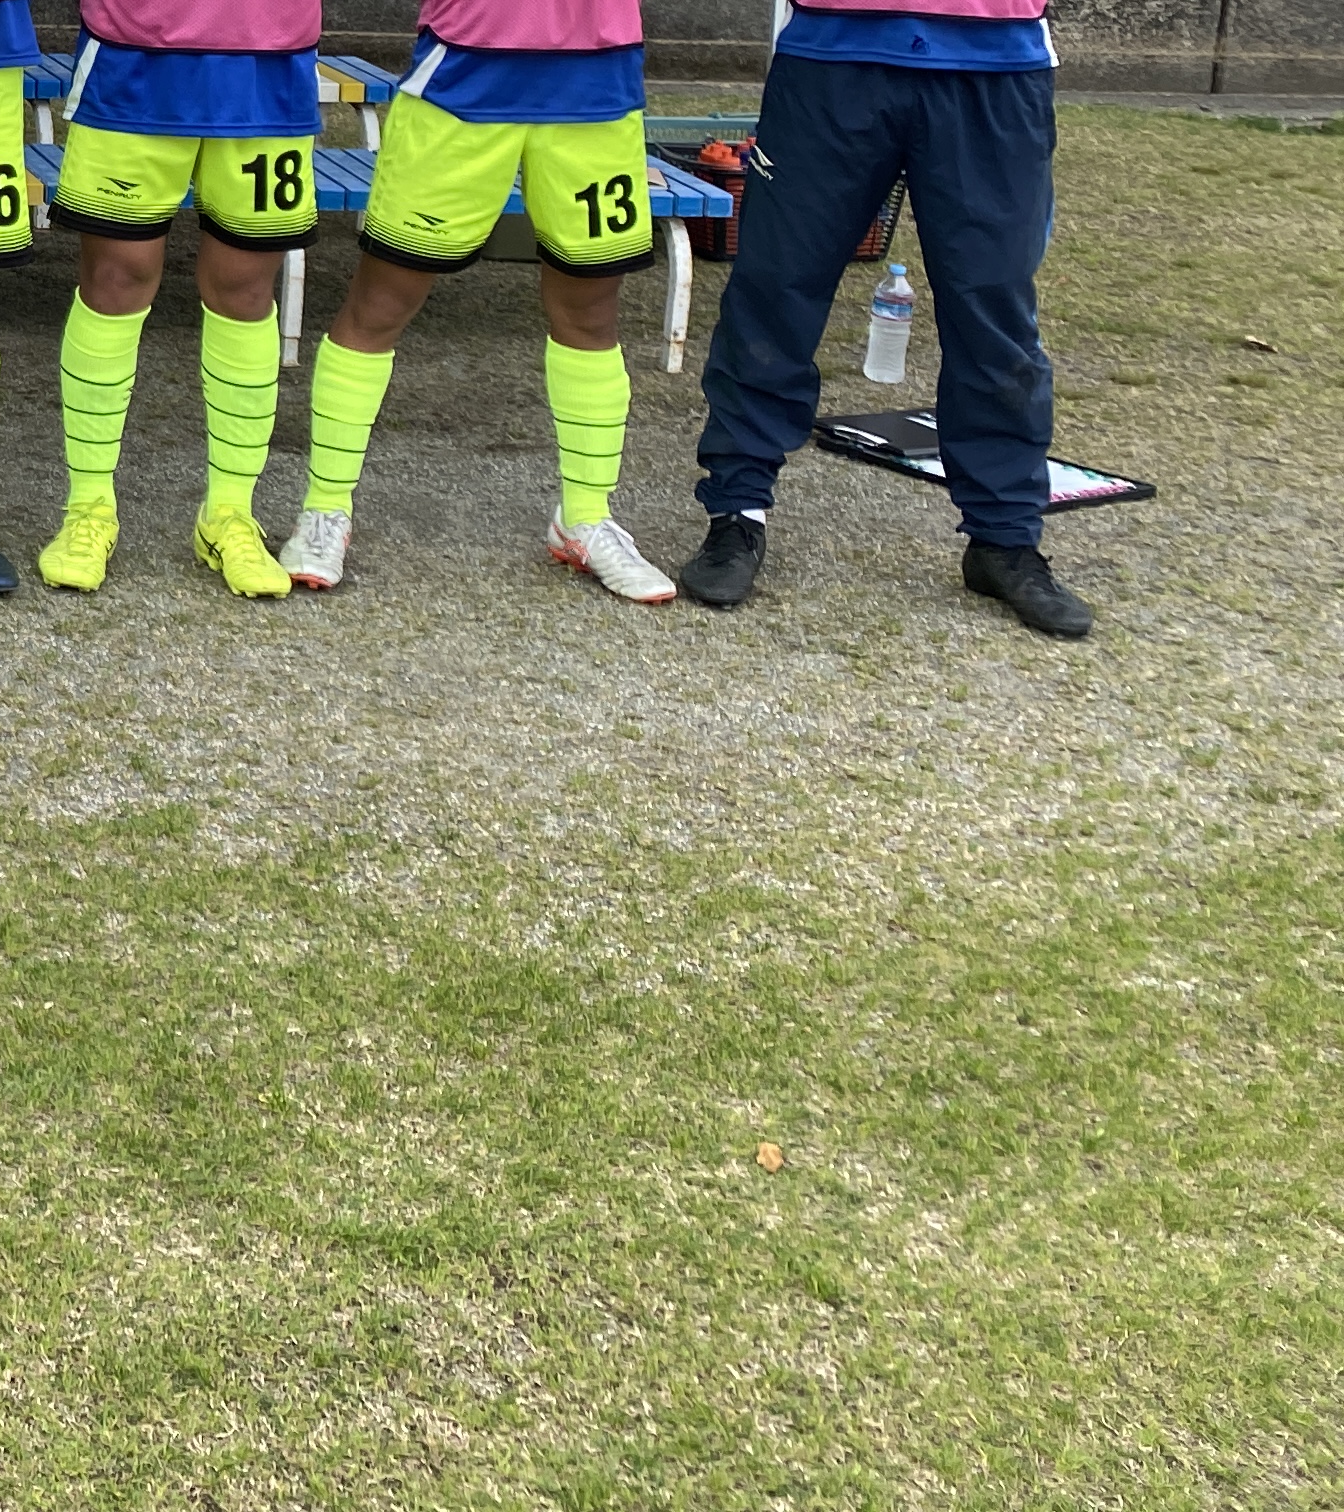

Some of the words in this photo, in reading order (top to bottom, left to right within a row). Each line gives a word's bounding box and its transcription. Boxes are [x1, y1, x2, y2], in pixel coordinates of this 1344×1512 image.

[96, 187, 143, 201] PENALTY
[240, 149, 305, 213] 18
[574, 173, 638, 239] 13
